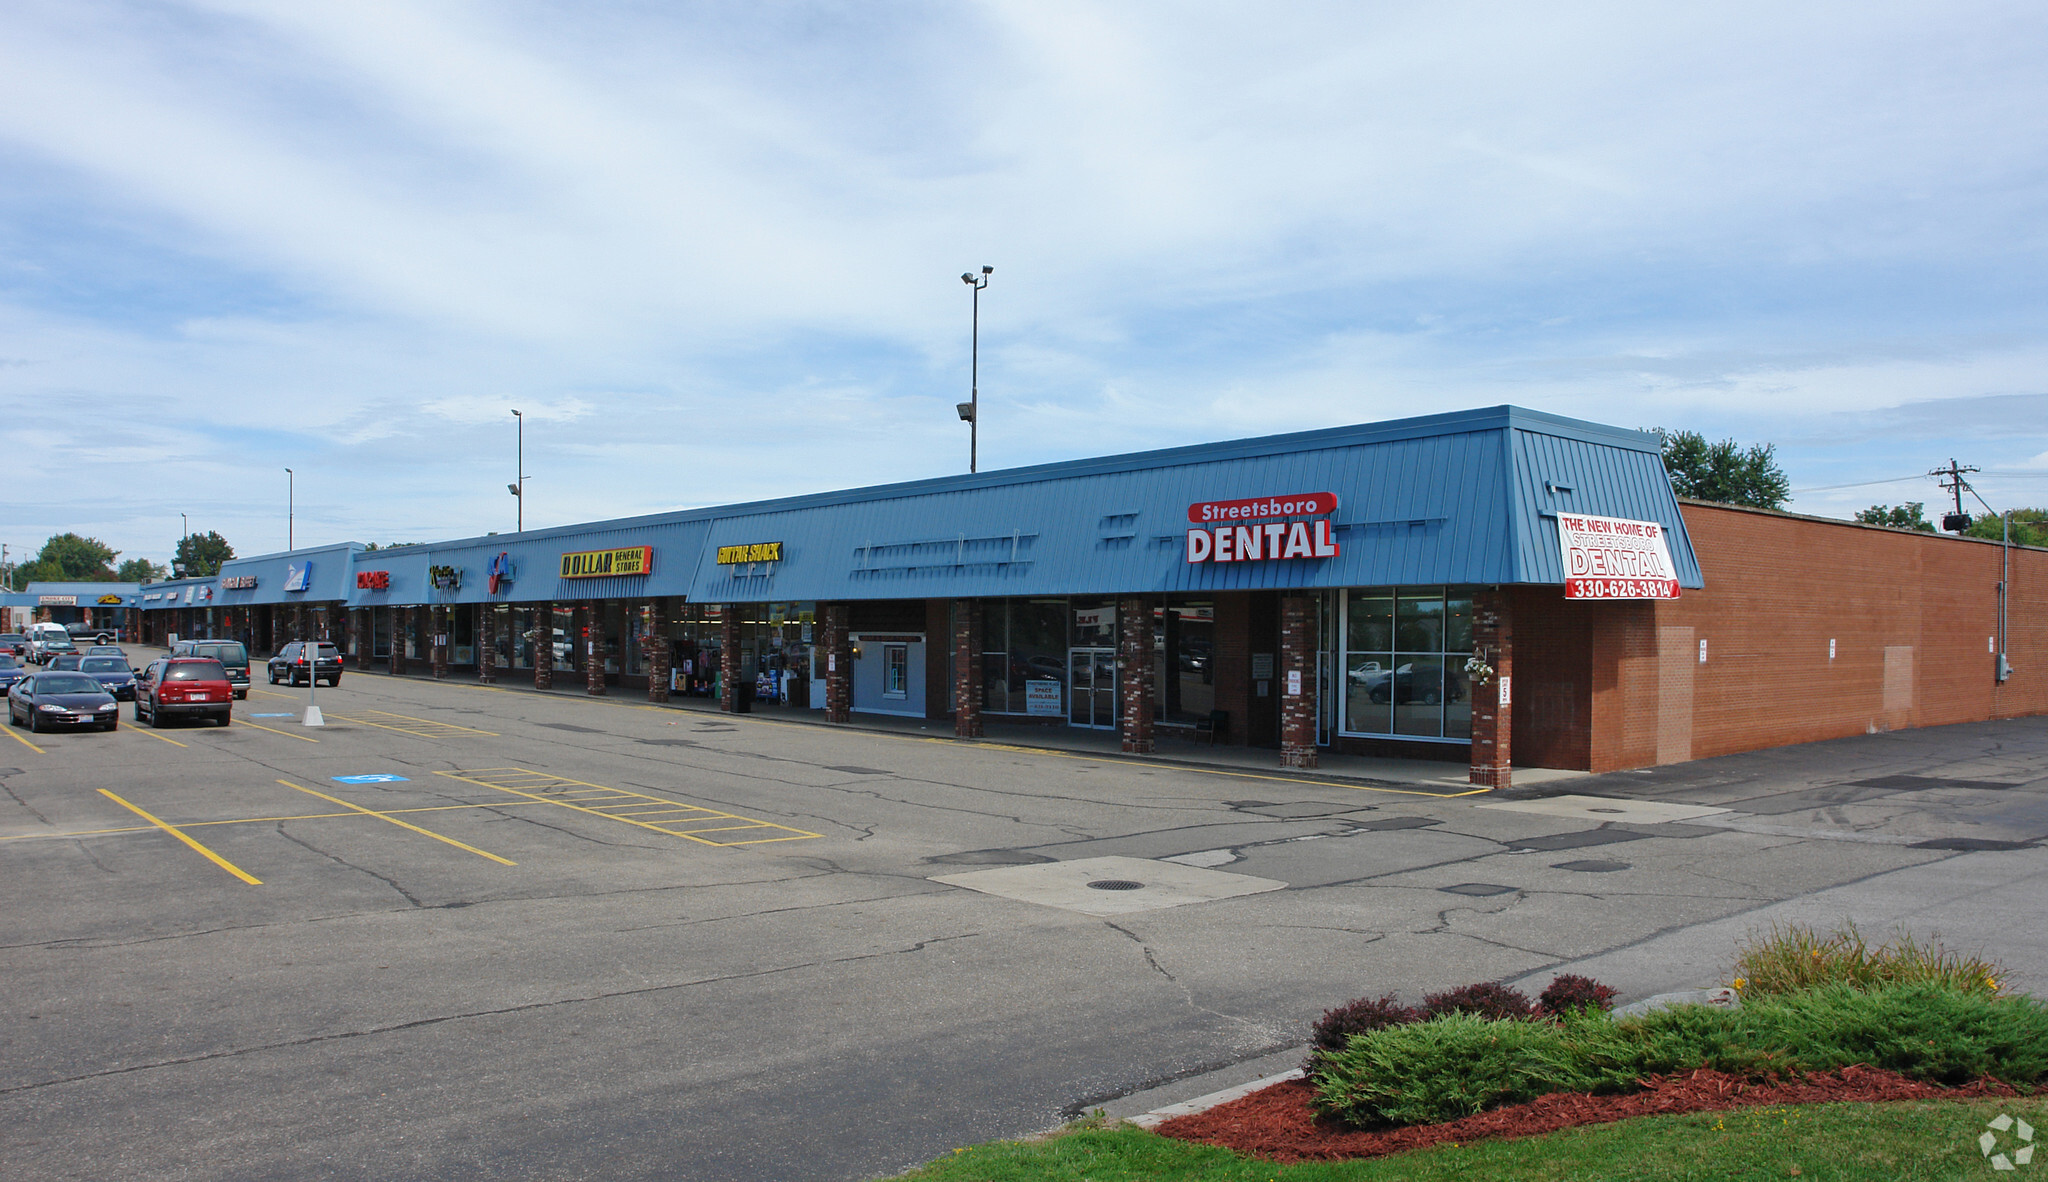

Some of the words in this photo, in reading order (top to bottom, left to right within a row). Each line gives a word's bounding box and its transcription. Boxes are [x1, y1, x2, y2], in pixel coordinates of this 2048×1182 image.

[1201, 498, 1318, 521] Streetsboro
[1562, 517, 1584, 532] THE
[1587, 519, 1612, 534] NEW
[1613, 521, 1644, 537] HOME
[1645, 525, 1658, 538] OF
[1187, 519, 1339, 563] DENTAL
[1572, 532, 1655, 552] STREETSBORO
[562, 552, 613, 576] DOLLAR
[615, 549, 643, 562] GENERAL
[717, 545, 749, 565] GUITAR
[748, 542, 781, 562] SHACK
[1569, 547, 1667, 578] DENTAL
[616, 560, 640, 573] STORES
[1574, 579, 1671, 598] 330-626-3814
[1503, 687, 1507, 697] 5
